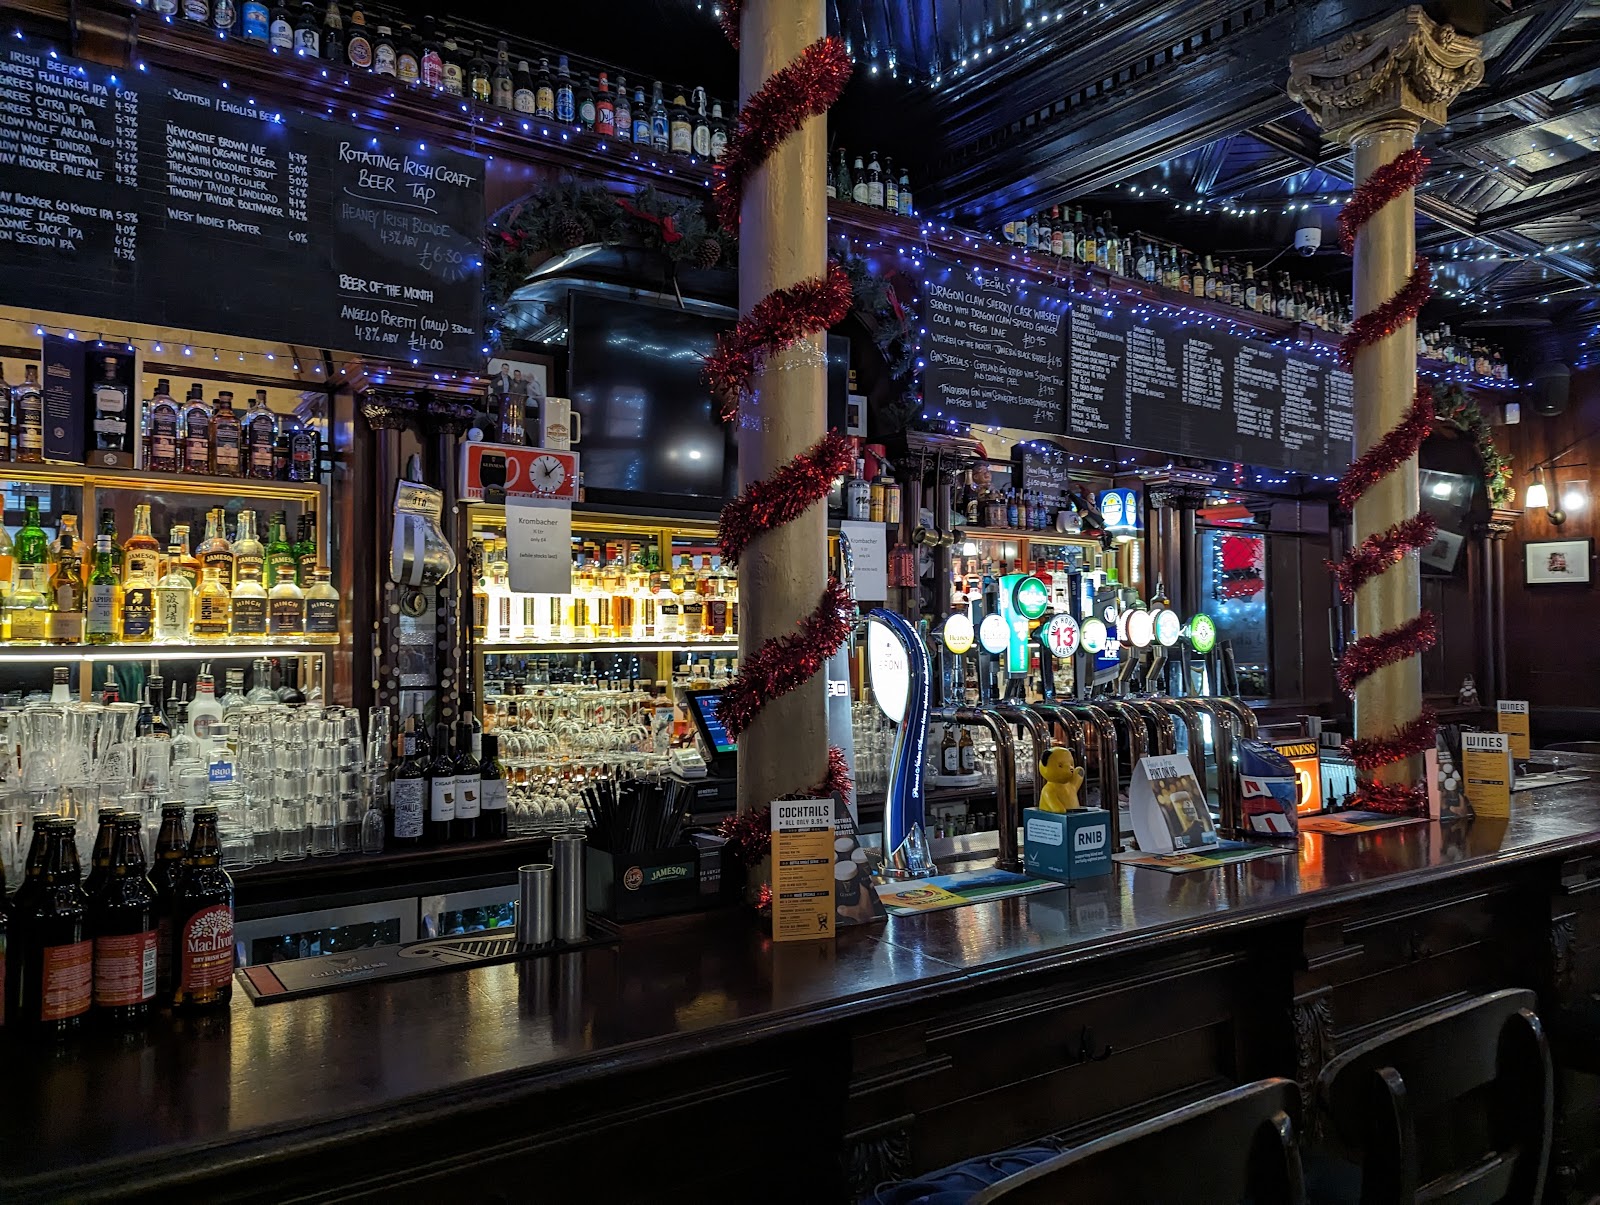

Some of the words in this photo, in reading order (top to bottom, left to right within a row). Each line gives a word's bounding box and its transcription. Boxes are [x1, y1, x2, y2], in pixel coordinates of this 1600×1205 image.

[10, 51, 40, 67] IRISH
[47, 60, 78, 76] BEER
[38, 71, 62, 84] FULL
[63, 76, 89, 91] IRISH
[92, 83, 108, 96] IPA
[35, 96, 66, 112] CITRA
[69, 103, 86, 116] IPA
[81, 94, 107, 108] GALE
[172, 88, 211, 108] SCOTTISH
[26, 119, 59, 134] WOLF
[60, 126, 98, 143] ARCADIA
[81, 118, 96, 131] IPA
[21, 131, 50, 145] WOLF
[52, 138, 92, 155] TUNDRA
[166, 123, 216, 144] NEWCASTLE
[217, 136, 248, 153] BROWN
[250, 143, 267, 157] ALE
[20, 143, 47, 157] WOLF
[50, 149, 98, 168] ELEVATION
[166, 134, 187, 147] SAM
[187, 140, 210, 155] SMITH
[212, 147, 247, 163] ORGANIC
[250, 155, 278, 170] LAGER
[19, 156, 60, 173] HOOKER
[63, 164, 84, 177] PALE
[86, 168, 105, 181] ALE
[166, 147, 186, 161] SAM
[187, 152, 210, 167] SMITH
[212, 158, 252, 176] CHOCOLATE
[253, 167, 278, 180] STOUT
[339, 141, 401, 172] ROTATING
[403, 155, 433, 180] IRISH
[435, 165, 476, 188] CRAFT
[166, 160, 212, 179] THEAKSTON
[214, 171, 230, 183] OLD
[232, 173, 268, 191] PECULIER
[166, 172, 203, 189] TIMOTHY
[204, 180, 238, 198] TAYLOR
[239, 187, 279, 204] LANDLORD
[358, 168, 397, 193] BEER
[405, 183, 436, 205] TAP
[15, 193, 53, 210] HOOKER
[56, 200, 70, 211] 60
[70, 203, 97, 216] KNOTS
[99, 209, 114, 221] IPA
[166, 185, 203, 202] TIMOTHY
[203, 192, 236, 208] TAYLOR
[238, 199, 284, 218] BOLTMAKER
[39, 211, 72, 226] LAGER
[167, 207, 195, 222] WEST
[196, 213, 225, 229] INDIES
[228, 219, 262, 235] PORTER
[383, 211, 408, 231] IRISH
[412, 216, 451, 238] BLONDE
[15, 232, 55, 247] SESSION
[59, 239, 76, 251] IPA
[34, 222, 61, 236] JACK
[68, 228, 84, 240] IPA
[339, 273, 369, 293] BEER
[369, 281, 383, 295] OF
[384, 283, 402, 298] THE
[404, 286, 434, 304] MONTH
[930, 283, 965, 302] DRAGON
[965, 291, 986, 308] CLAW
[986, 297, 1013, 318] SHERRY
[1013, 304, 1032, 319] CASK
[1034, 309, 1061, 330] WHISKEY
[340, 304, 379, 323] ANGELO
[381, 309, 417, 331] PORETTI
[933, 313, 951, 327] COLA
[954, 319, 967, 329] AND
[968, 321, 988, 335] FRESH
[970, 307, 995, 322] DRAGON
[995, 312, 1012, 326] CLAW
[1012, 318, 1034, 331] SPICED
[1035, 323, 1058, 338] GINGER
[382, 332, 399, 344] ABV
[408, 331, 444, 352] £4.00
[518, 517, 559, 526] Krombacher
[850, 537, 878, 545] Krombacher
[128, 552, 157, 561] JAMESON
[205, 552, 233, 564] JAMESON
[201, 597, 212, 621] HINCH
[236, 600, 262, 609] HINCH
[273, 600, 299, 609] HINCH
[311, 601, 336, 609] HINCH
[1051, 620, 1059, 636] HOP
[1053, 626, 1074, 647] 13
[1500, 703, 1525, 711] WINES
[1274, 743, 1317, 757] GUINNESS
[1466, 736, 1503, 748] WINES
[211, 768, 231, 776] 1800
[779, 805, 829, 818] COCKTAILS
[1078, 831, 1102, 845] RNIB
[651, 866, 688, 881] JAMESON
